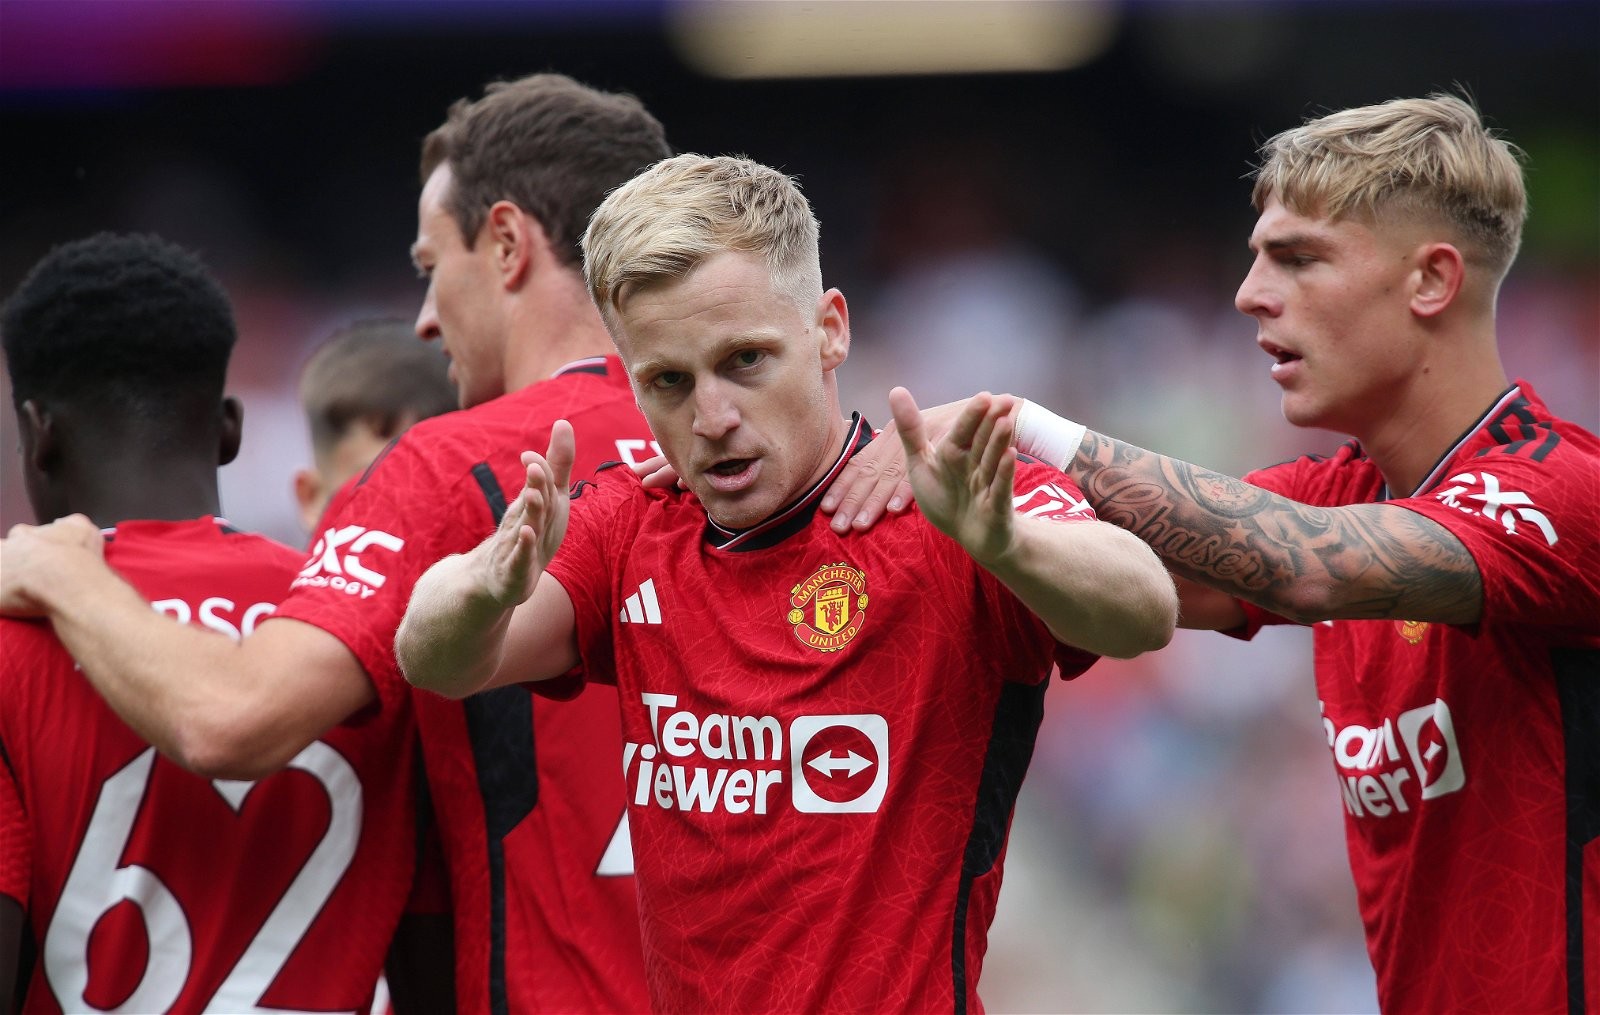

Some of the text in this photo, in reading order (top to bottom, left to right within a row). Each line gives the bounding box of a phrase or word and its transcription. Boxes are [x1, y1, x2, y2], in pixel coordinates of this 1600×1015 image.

[797, 569, 863, 602] MANCHESTER
[809, 626, 857, 646] UNITED
[641, 692, 783, 761] Team
[44, 739, 364, 1015] 62
